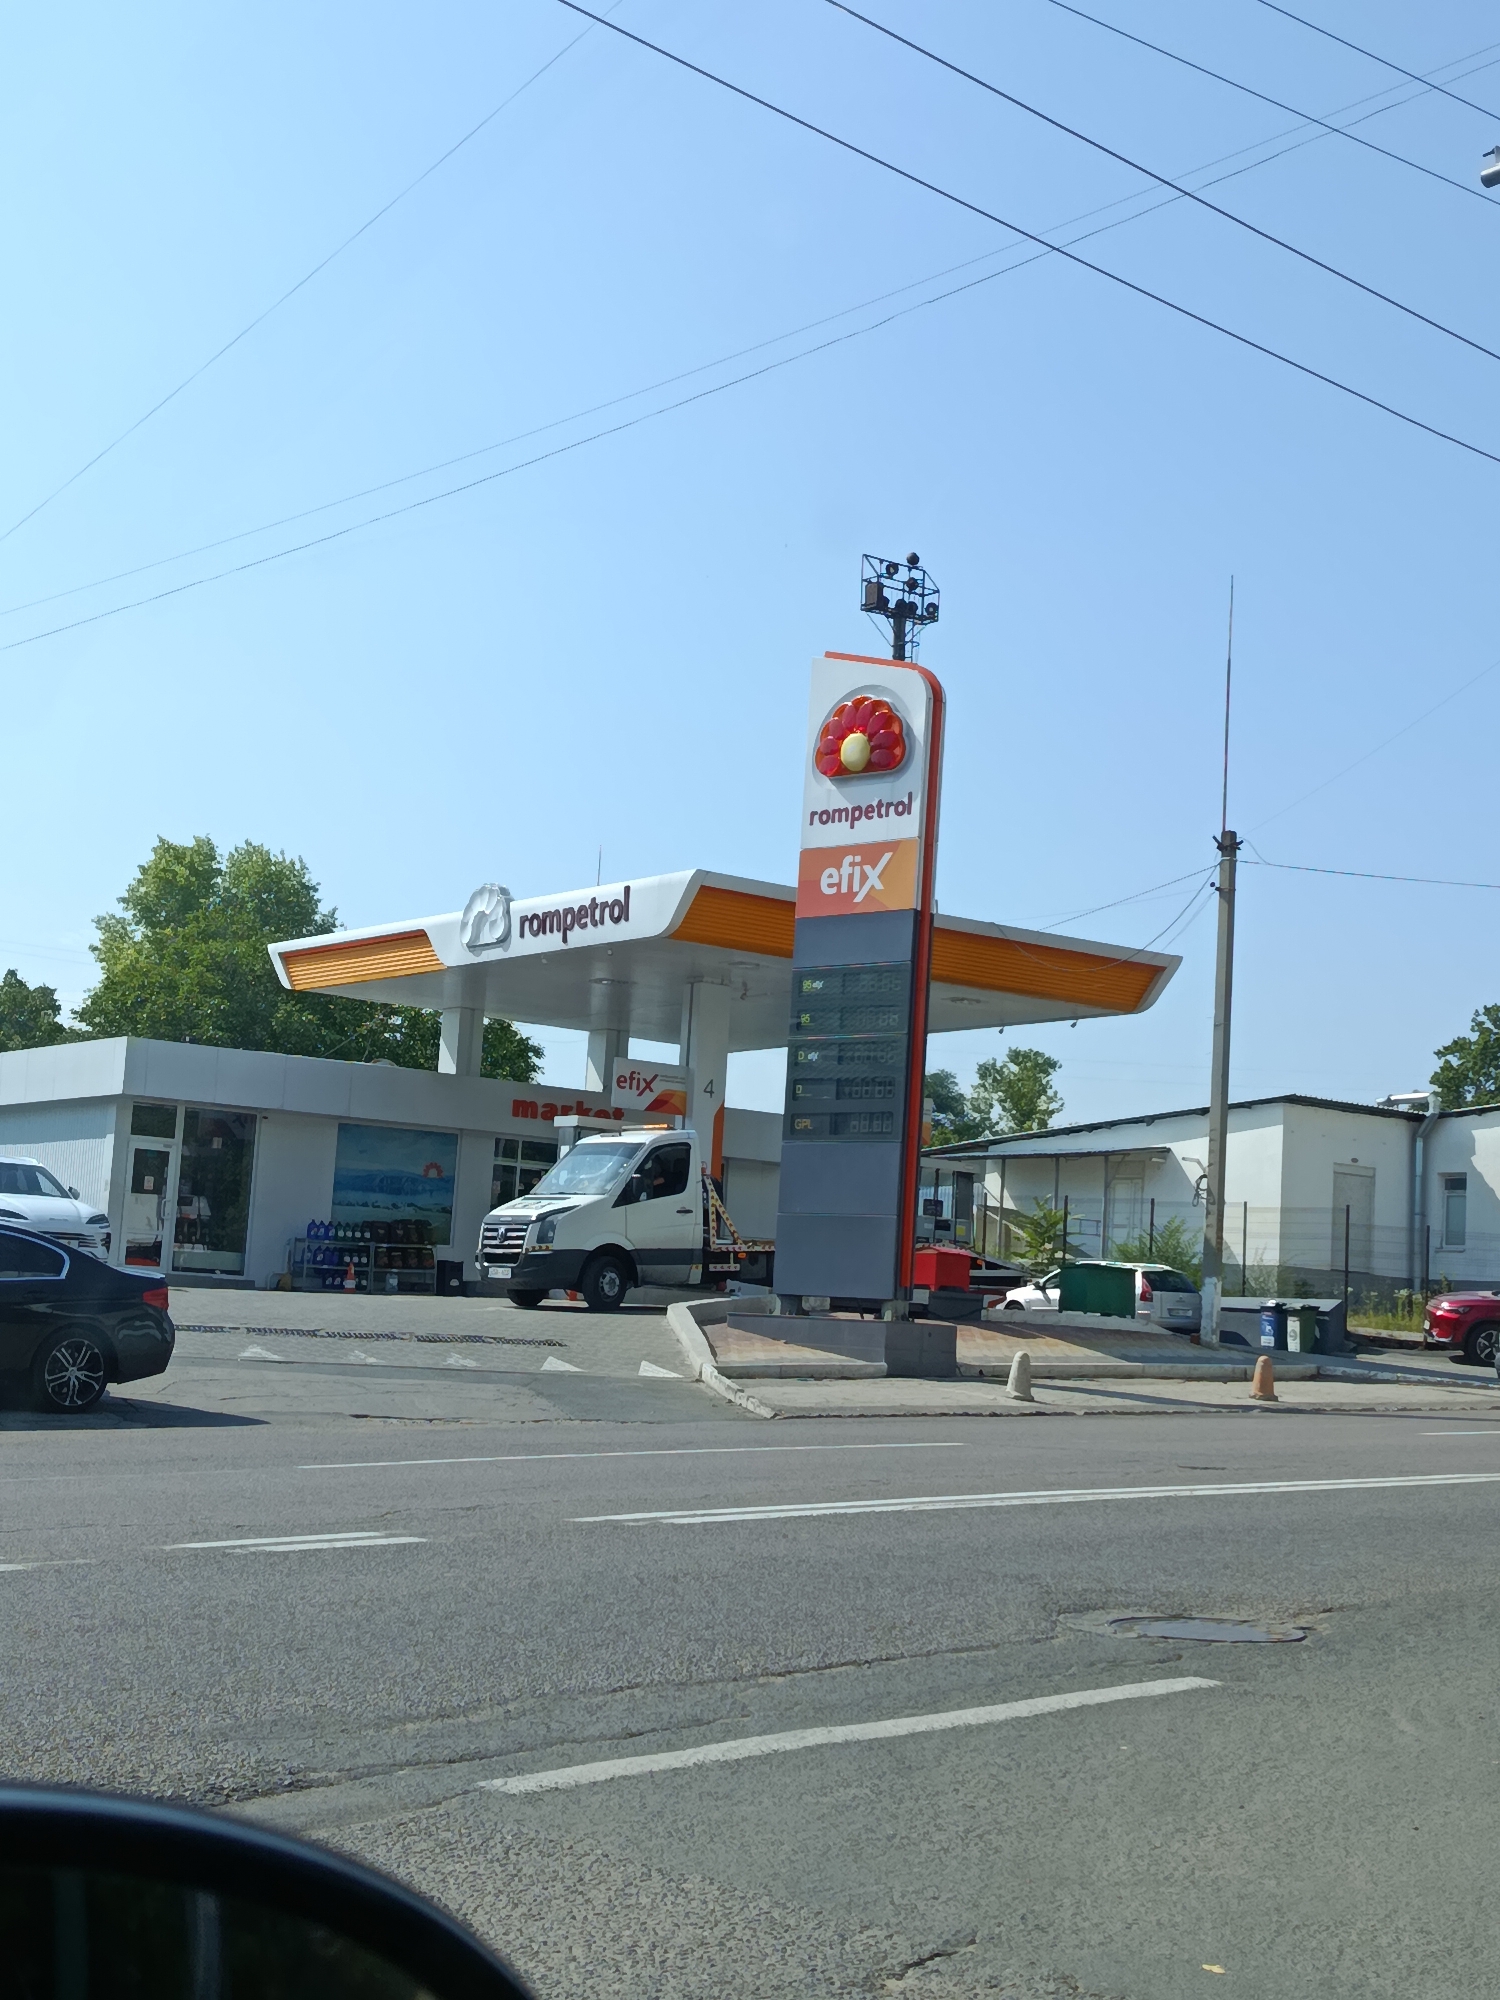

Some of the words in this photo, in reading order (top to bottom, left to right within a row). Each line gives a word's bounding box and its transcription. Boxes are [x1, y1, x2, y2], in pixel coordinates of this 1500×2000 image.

[809, 792, 913, 829] rompetrol
[820, 852, 893, 903] efix
[519, 885, 630, 944] rompetrol
[798, 1051, 805, 1061] D
[616, 1070, 659, 1097] efix
[703, 1079, 715, 1099] 4
[795, 1084, 802, 1094] D
[794, 1118, 813, 1130] GPL
